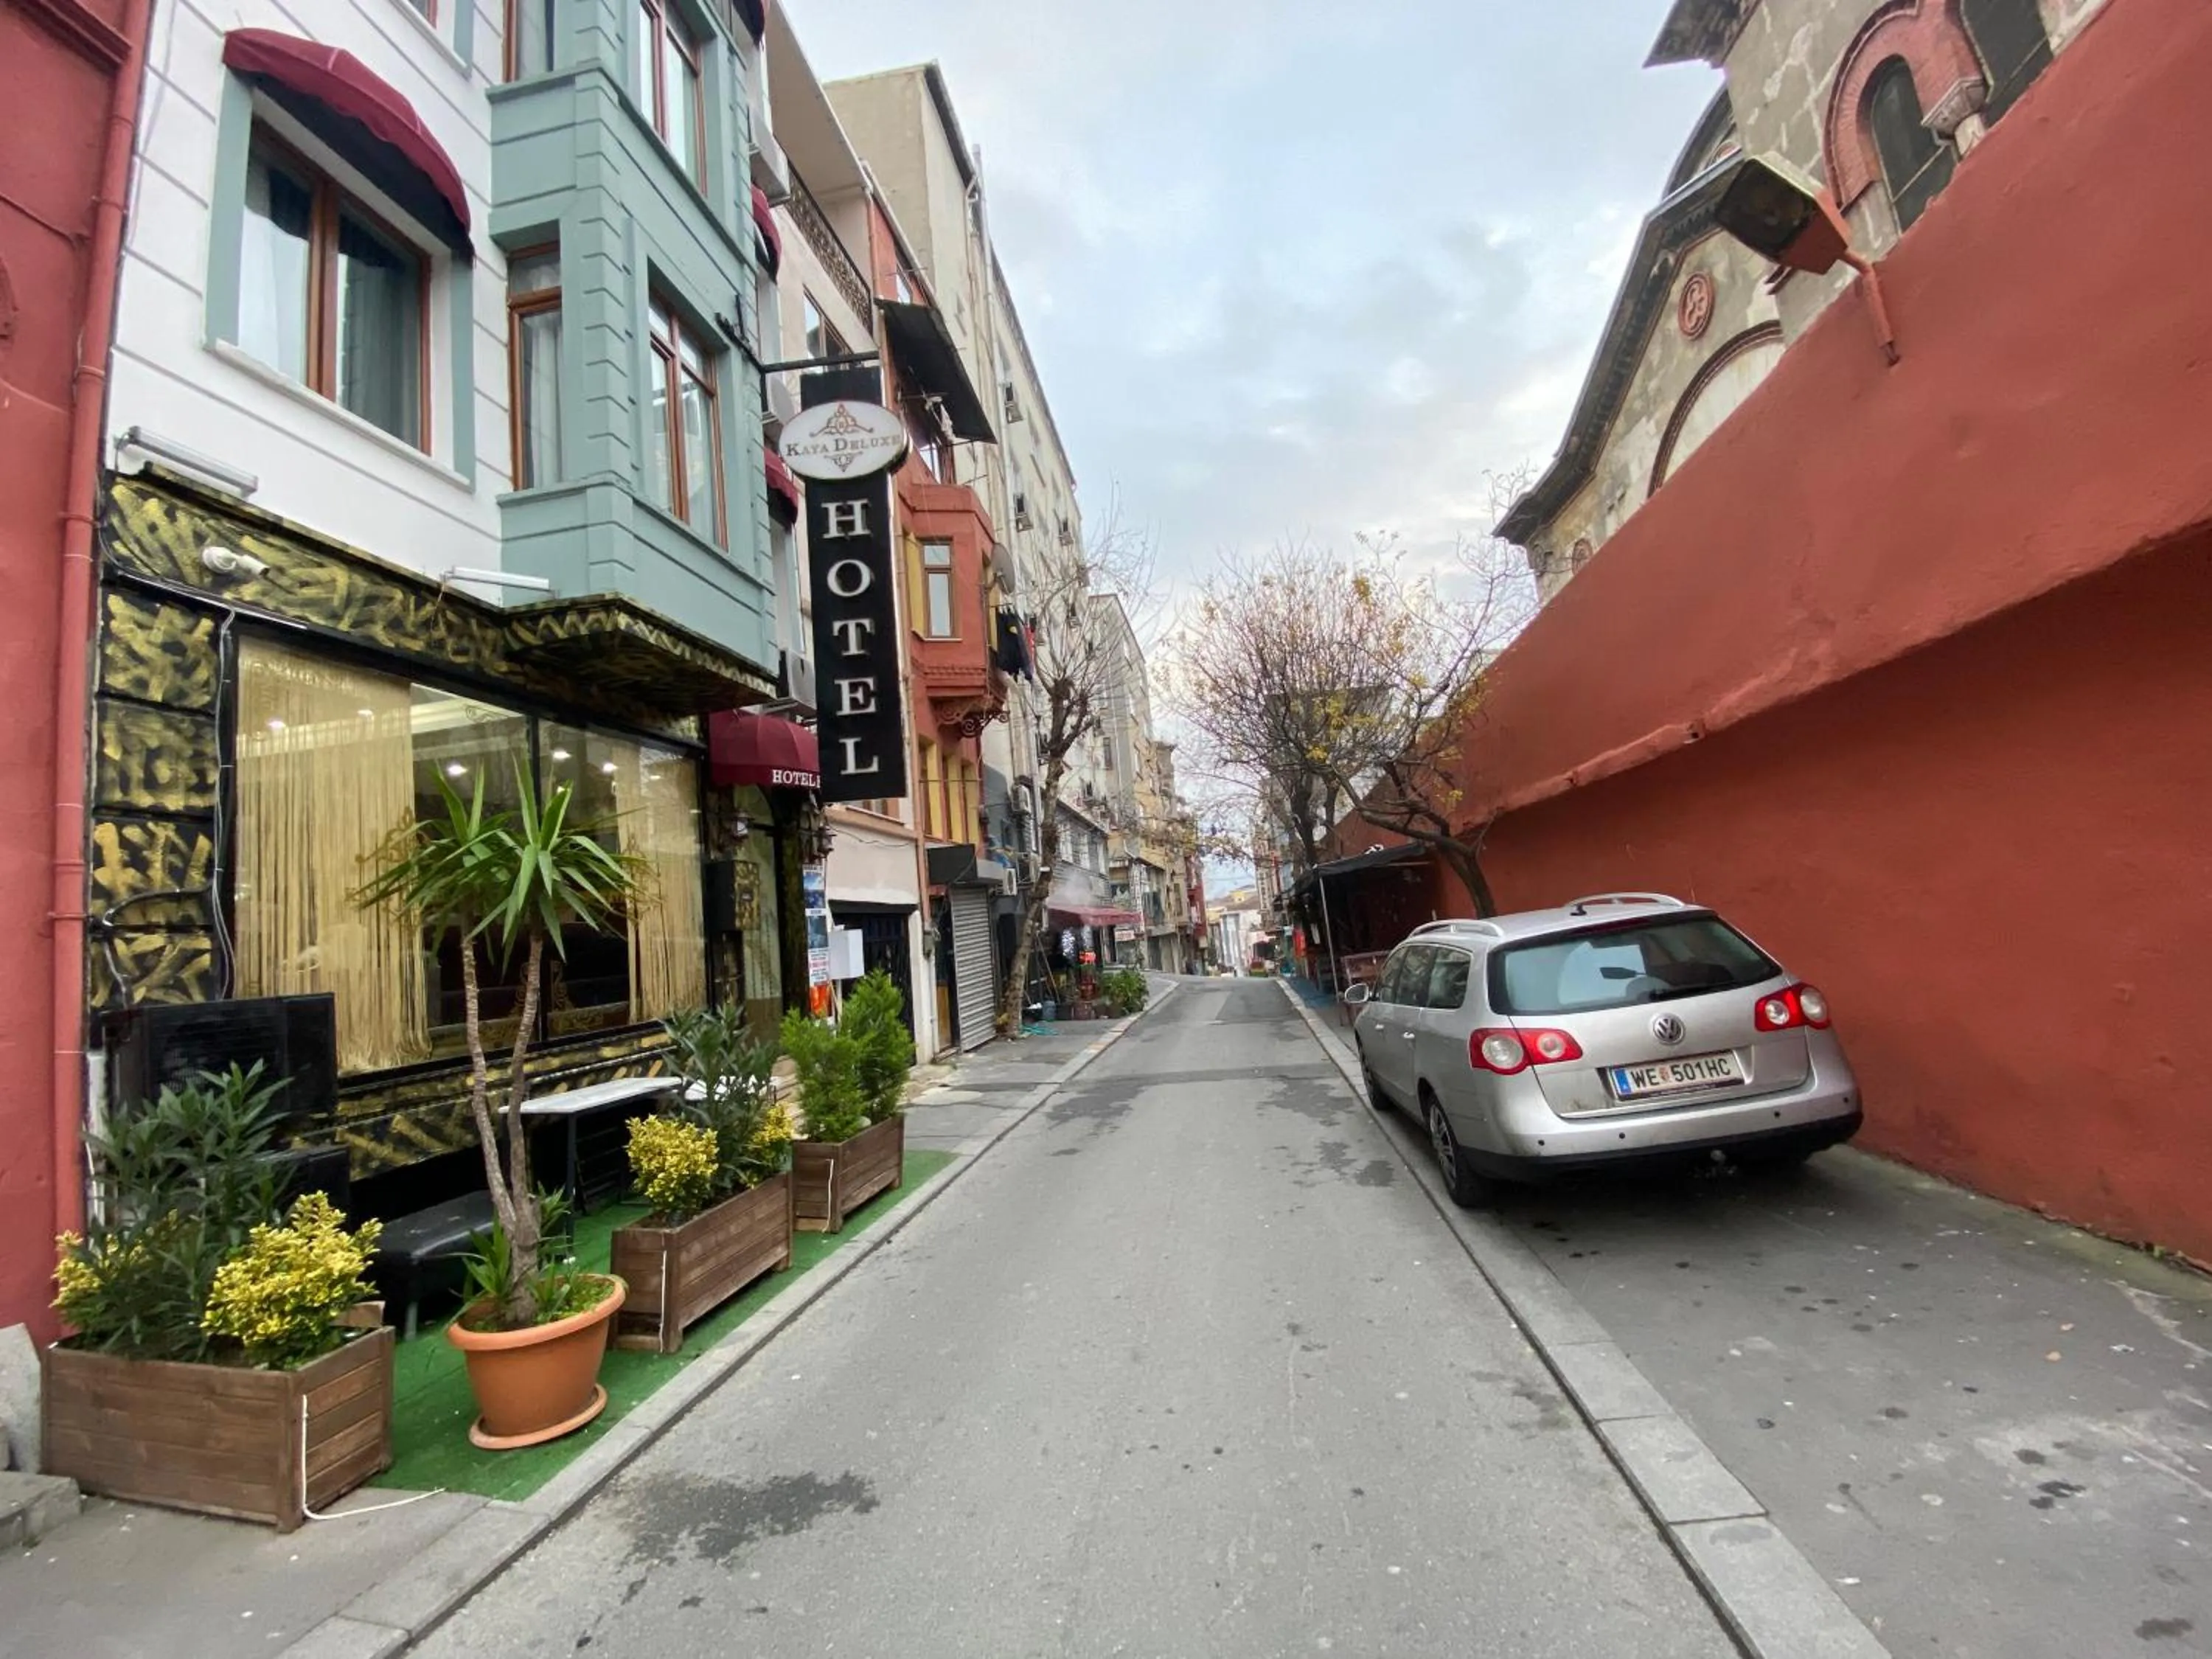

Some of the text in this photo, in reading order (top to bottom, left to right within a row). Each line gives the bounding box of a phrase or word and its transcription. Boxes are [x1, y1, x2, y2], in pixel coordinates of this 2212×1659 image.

[821, 499, 879, 775] HOTEL
[1630, 1058, 1731, 1088] WE 501HC
